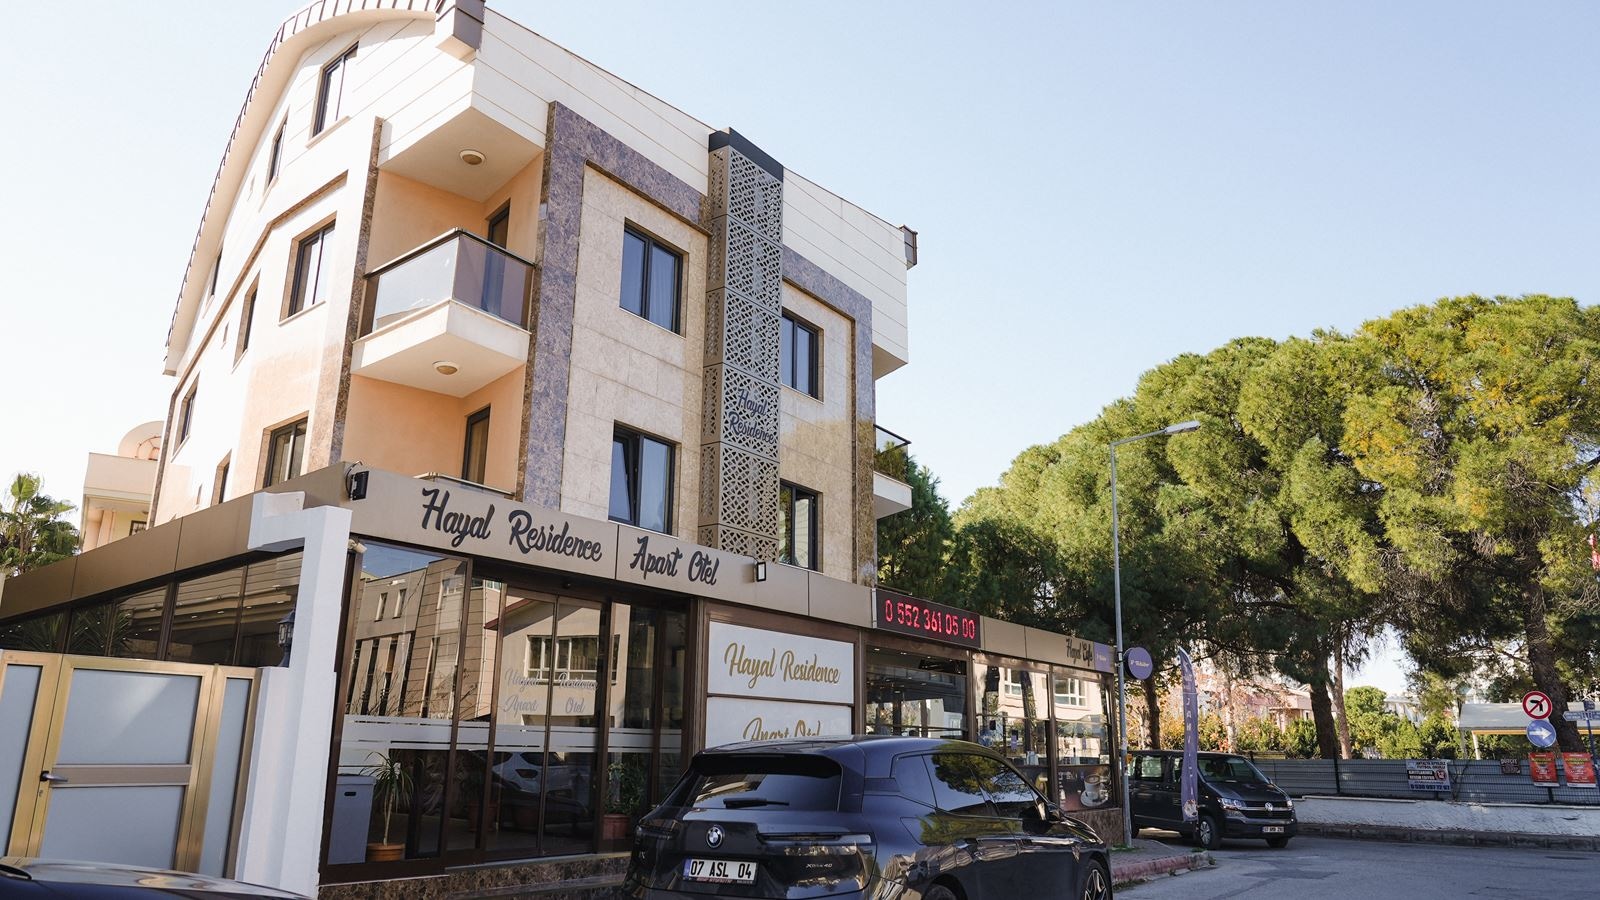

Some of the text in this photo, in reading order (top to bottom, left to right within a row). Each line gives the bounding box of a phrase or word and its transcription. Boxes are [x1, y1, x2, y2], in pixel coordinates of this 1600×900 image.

[738, 388, 767, 417] Hayal
[728, 411, 774, 444] Residence
[422, 488, 602, 562] Hayal Residence
[630, 536, 720, 585] Apart Otel
[885, 599, 975, 639] 0 552 361 05 00
[724, 642, 841, 689] Hayal Residence
[503, 694, 585, 718] Apart Otel
[690, 861, 752, 879] 07 ASL 04
